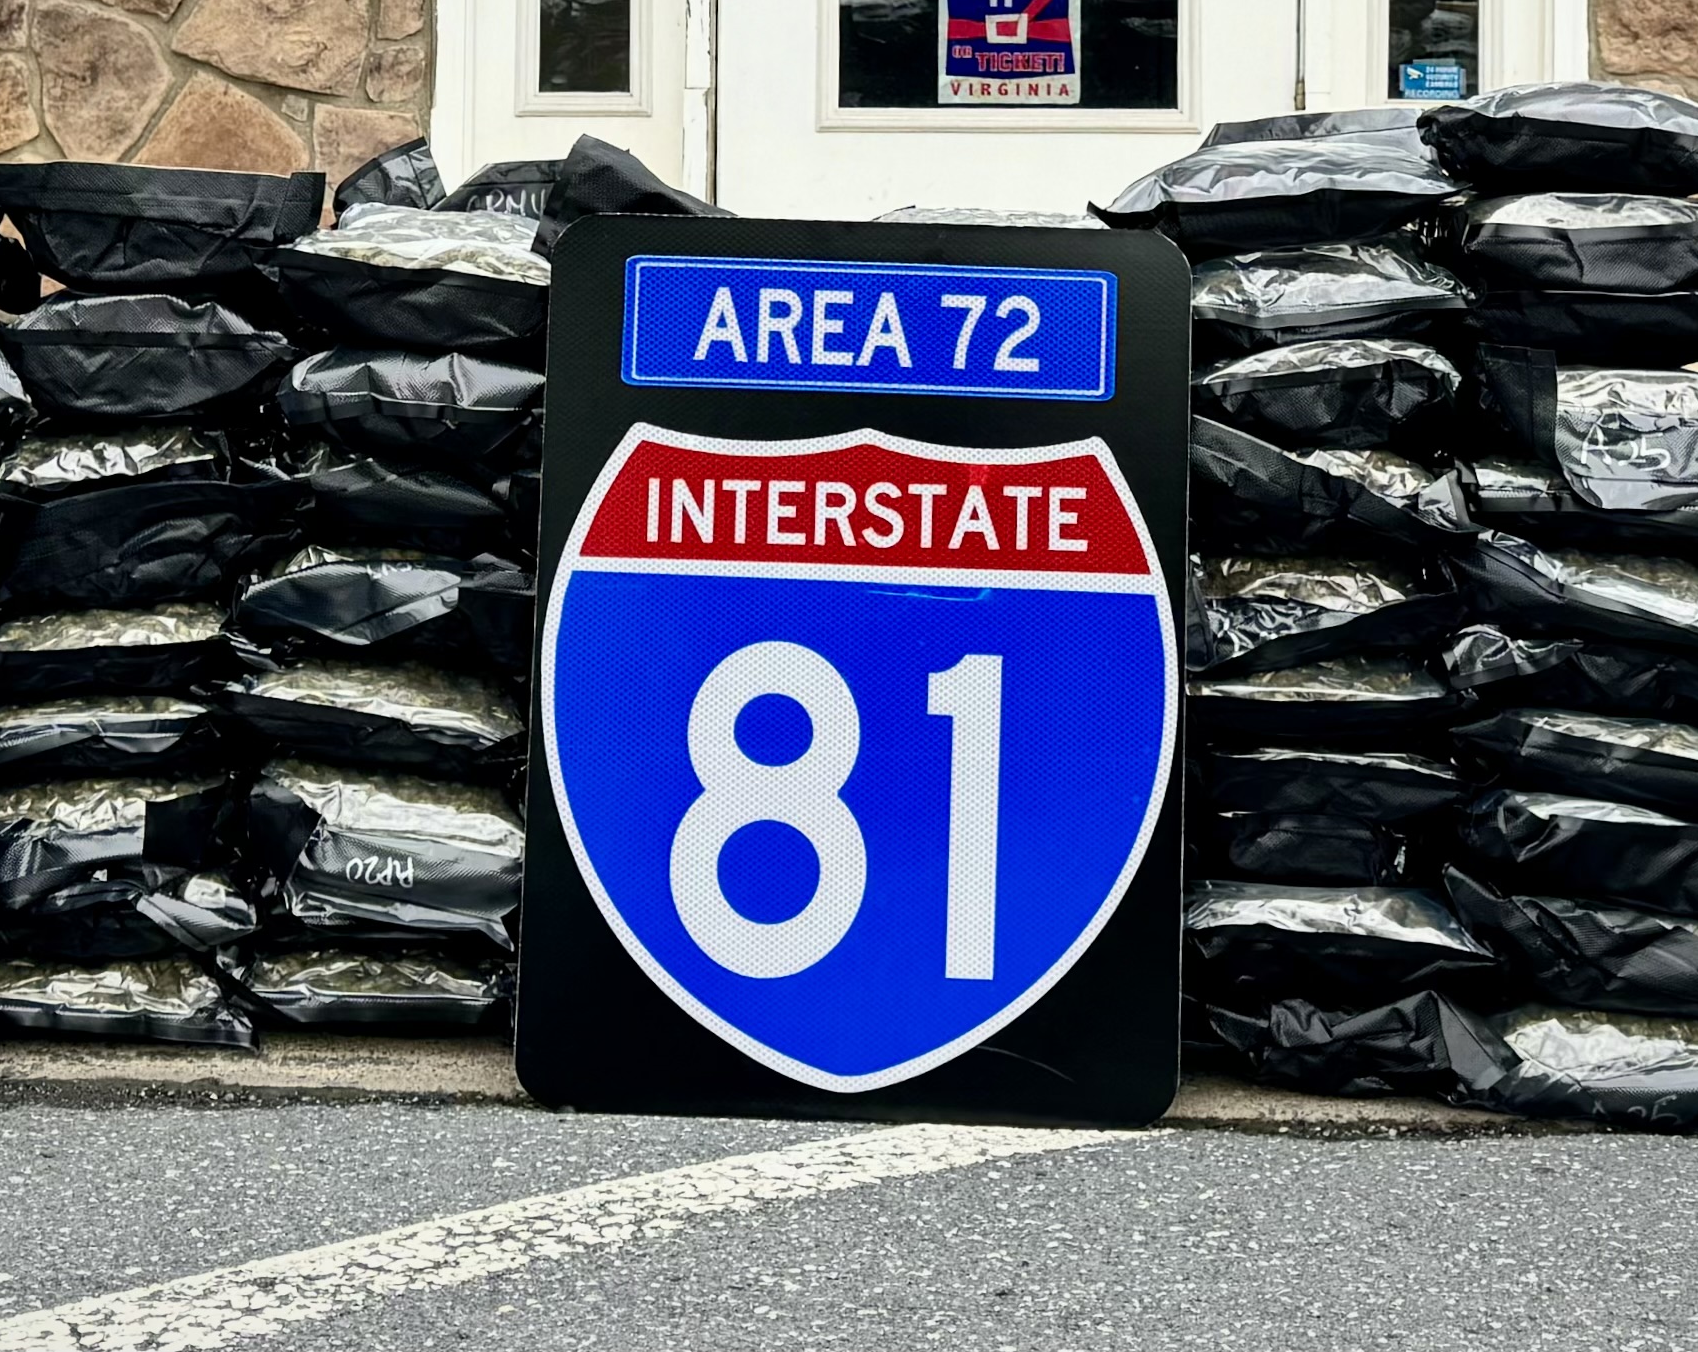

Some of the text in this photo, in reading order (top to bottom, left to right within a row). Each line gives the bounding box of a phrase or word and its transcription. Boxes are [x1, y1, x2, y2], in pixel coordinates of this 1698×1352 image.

[951, 83, 1069, 96] VIRGINIA
[952, 45, 1065, 72] OR TICKET!
[694, 286, 1041, 373] AREA 72
[646, 477, 1089, 552] INTERSTATE
[669, 640, 1004, 982] 81
